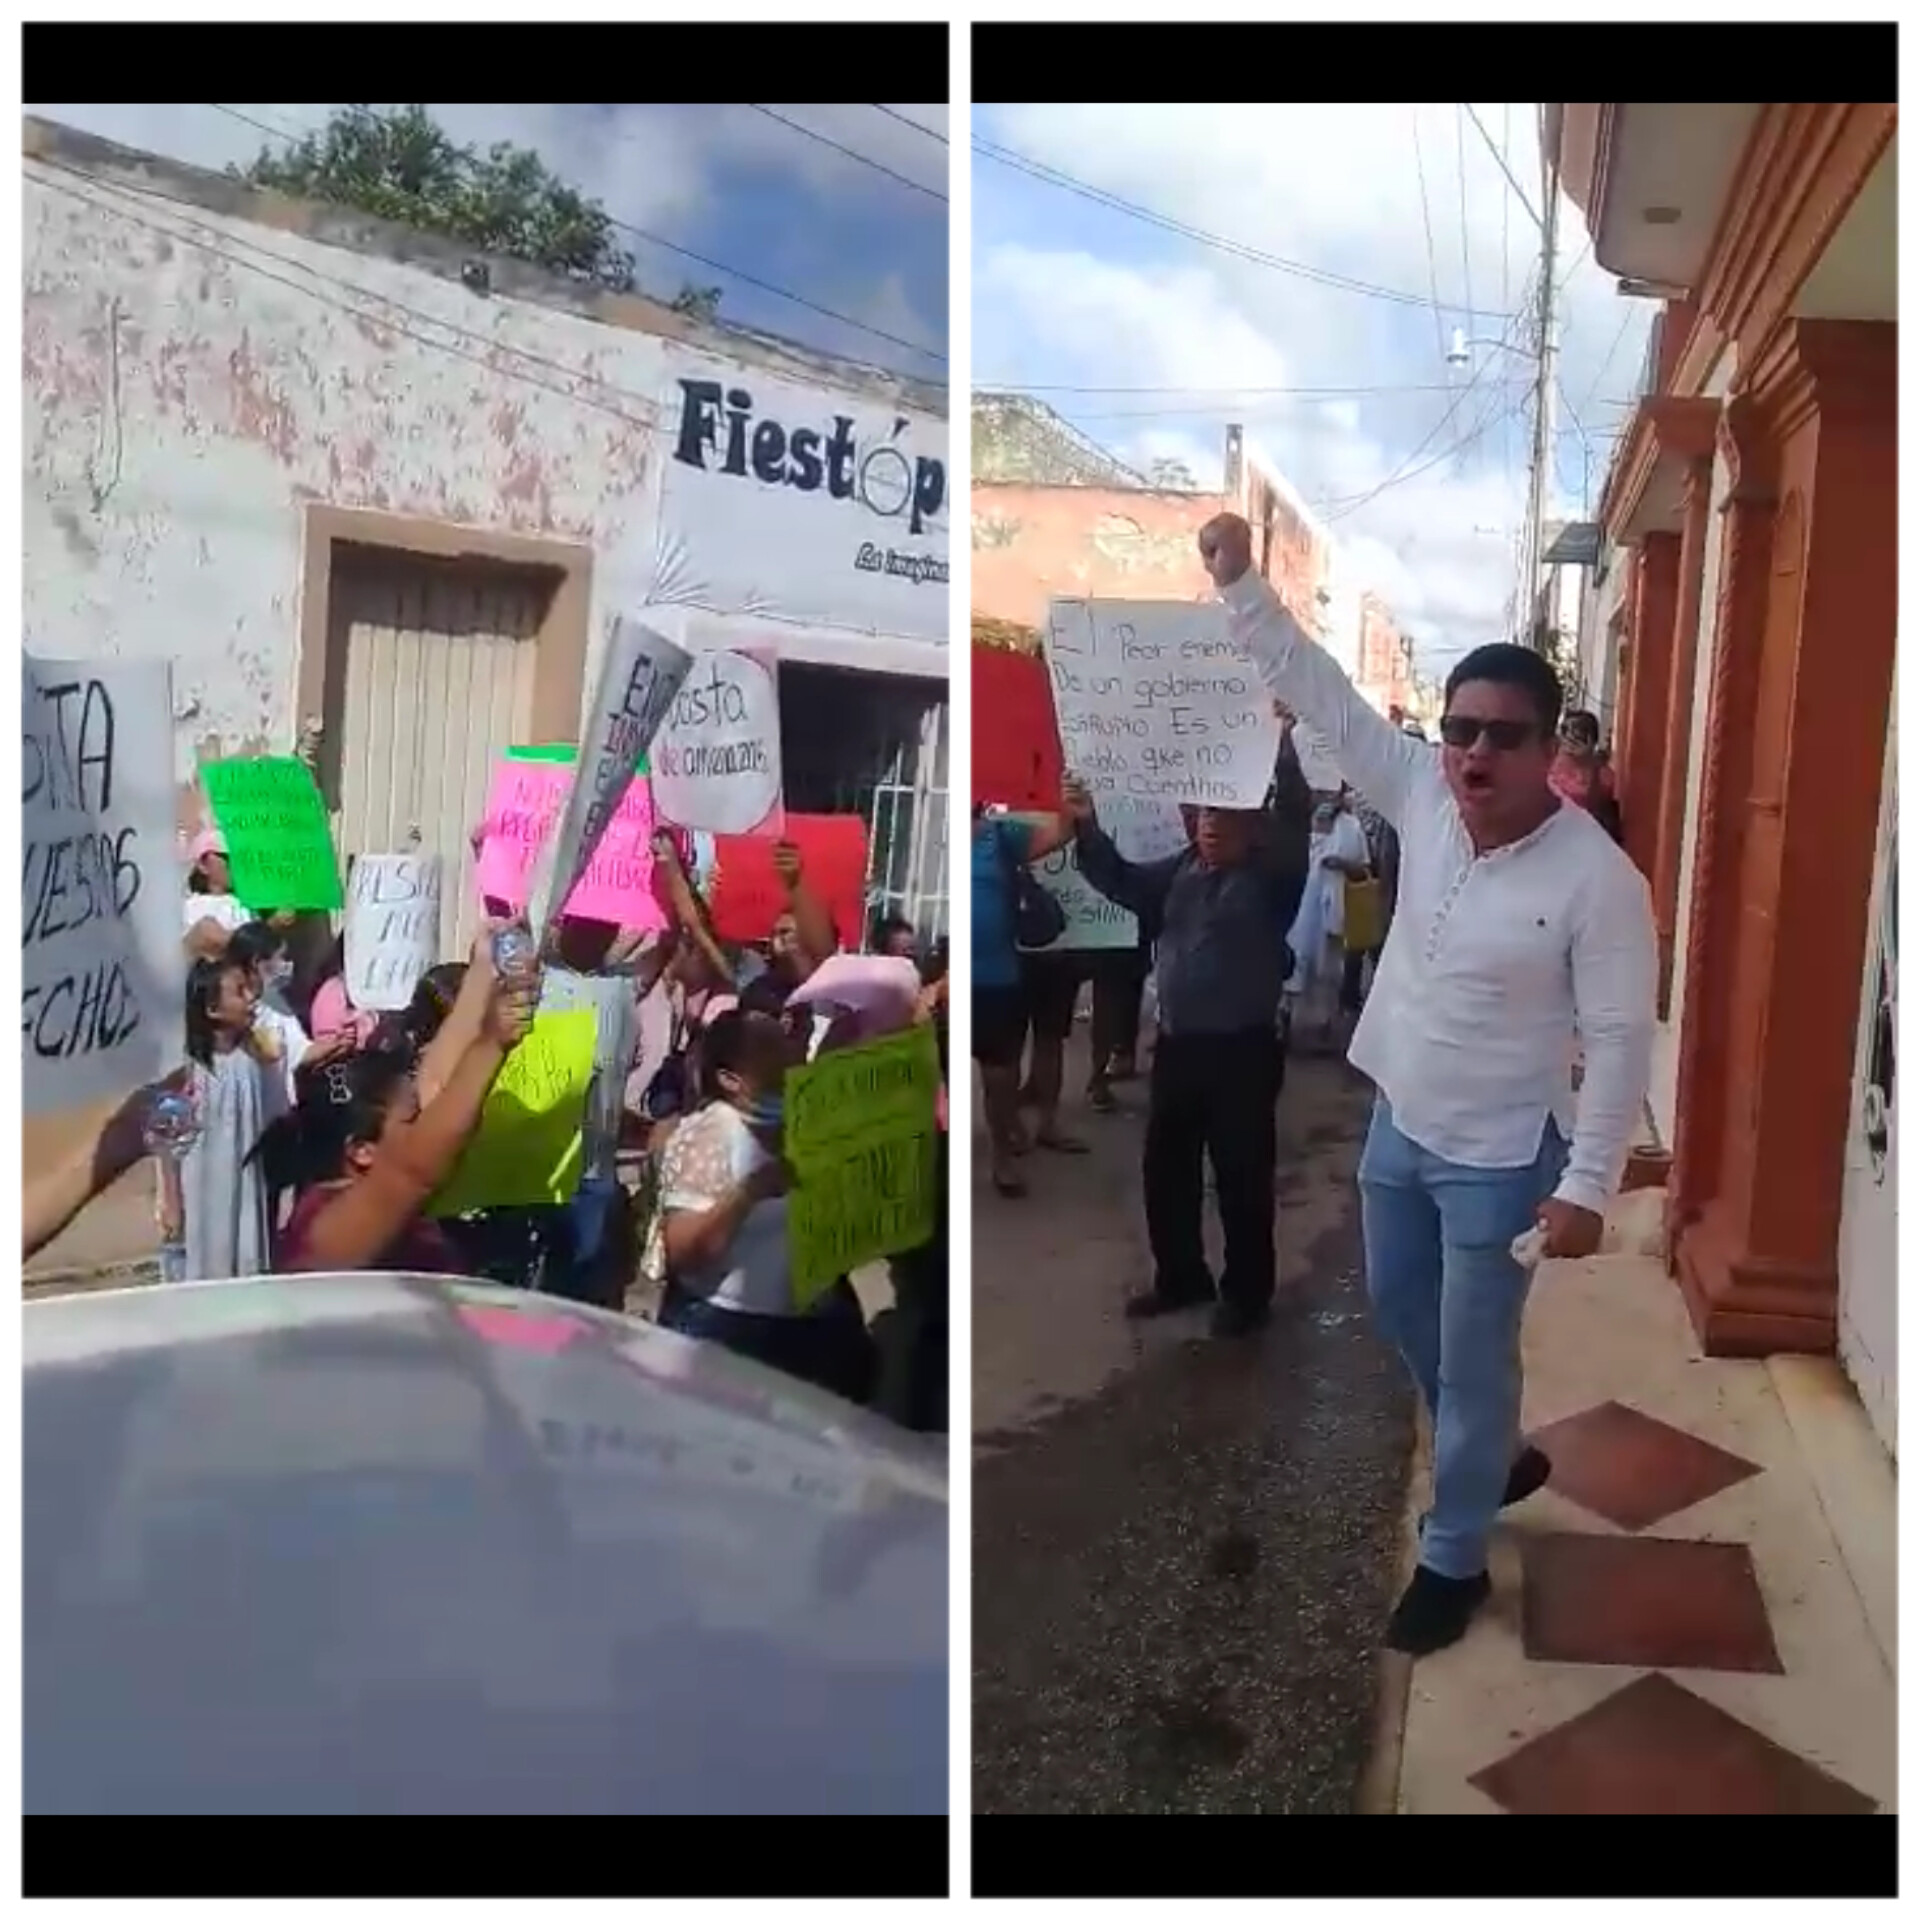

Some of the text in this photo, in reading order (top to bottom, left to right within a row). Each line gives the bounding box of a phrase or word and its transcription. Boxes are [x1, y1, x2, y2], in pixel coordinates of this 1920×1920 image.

[1050, 600, 1096, 656] El
[669, 661, 748, 733] asta
[1132, 671, 1247, 709] gobierno
[1169, 706, 1211, 735] Es
